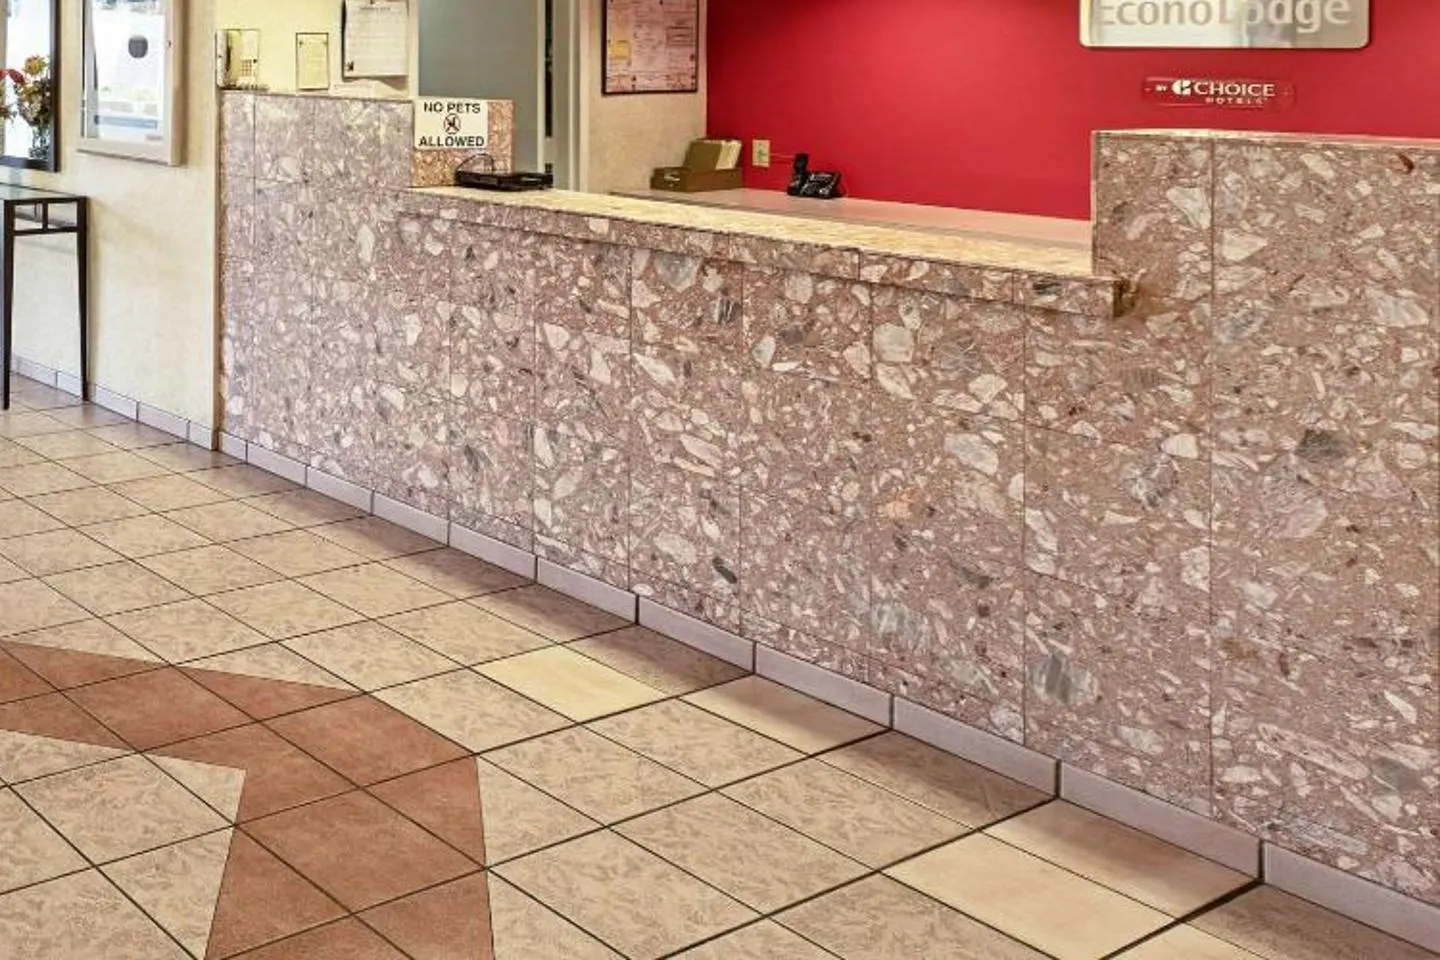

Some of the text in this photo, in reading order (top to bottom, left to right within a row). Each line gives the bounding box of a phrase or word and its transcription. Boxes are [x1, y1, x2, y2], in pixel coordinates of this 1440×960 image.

[1193, 81, 1276, 97] CHOICE
[423, 101, 481, 114] NO PETS
[418, 135, 485, 147] ALLOWED
